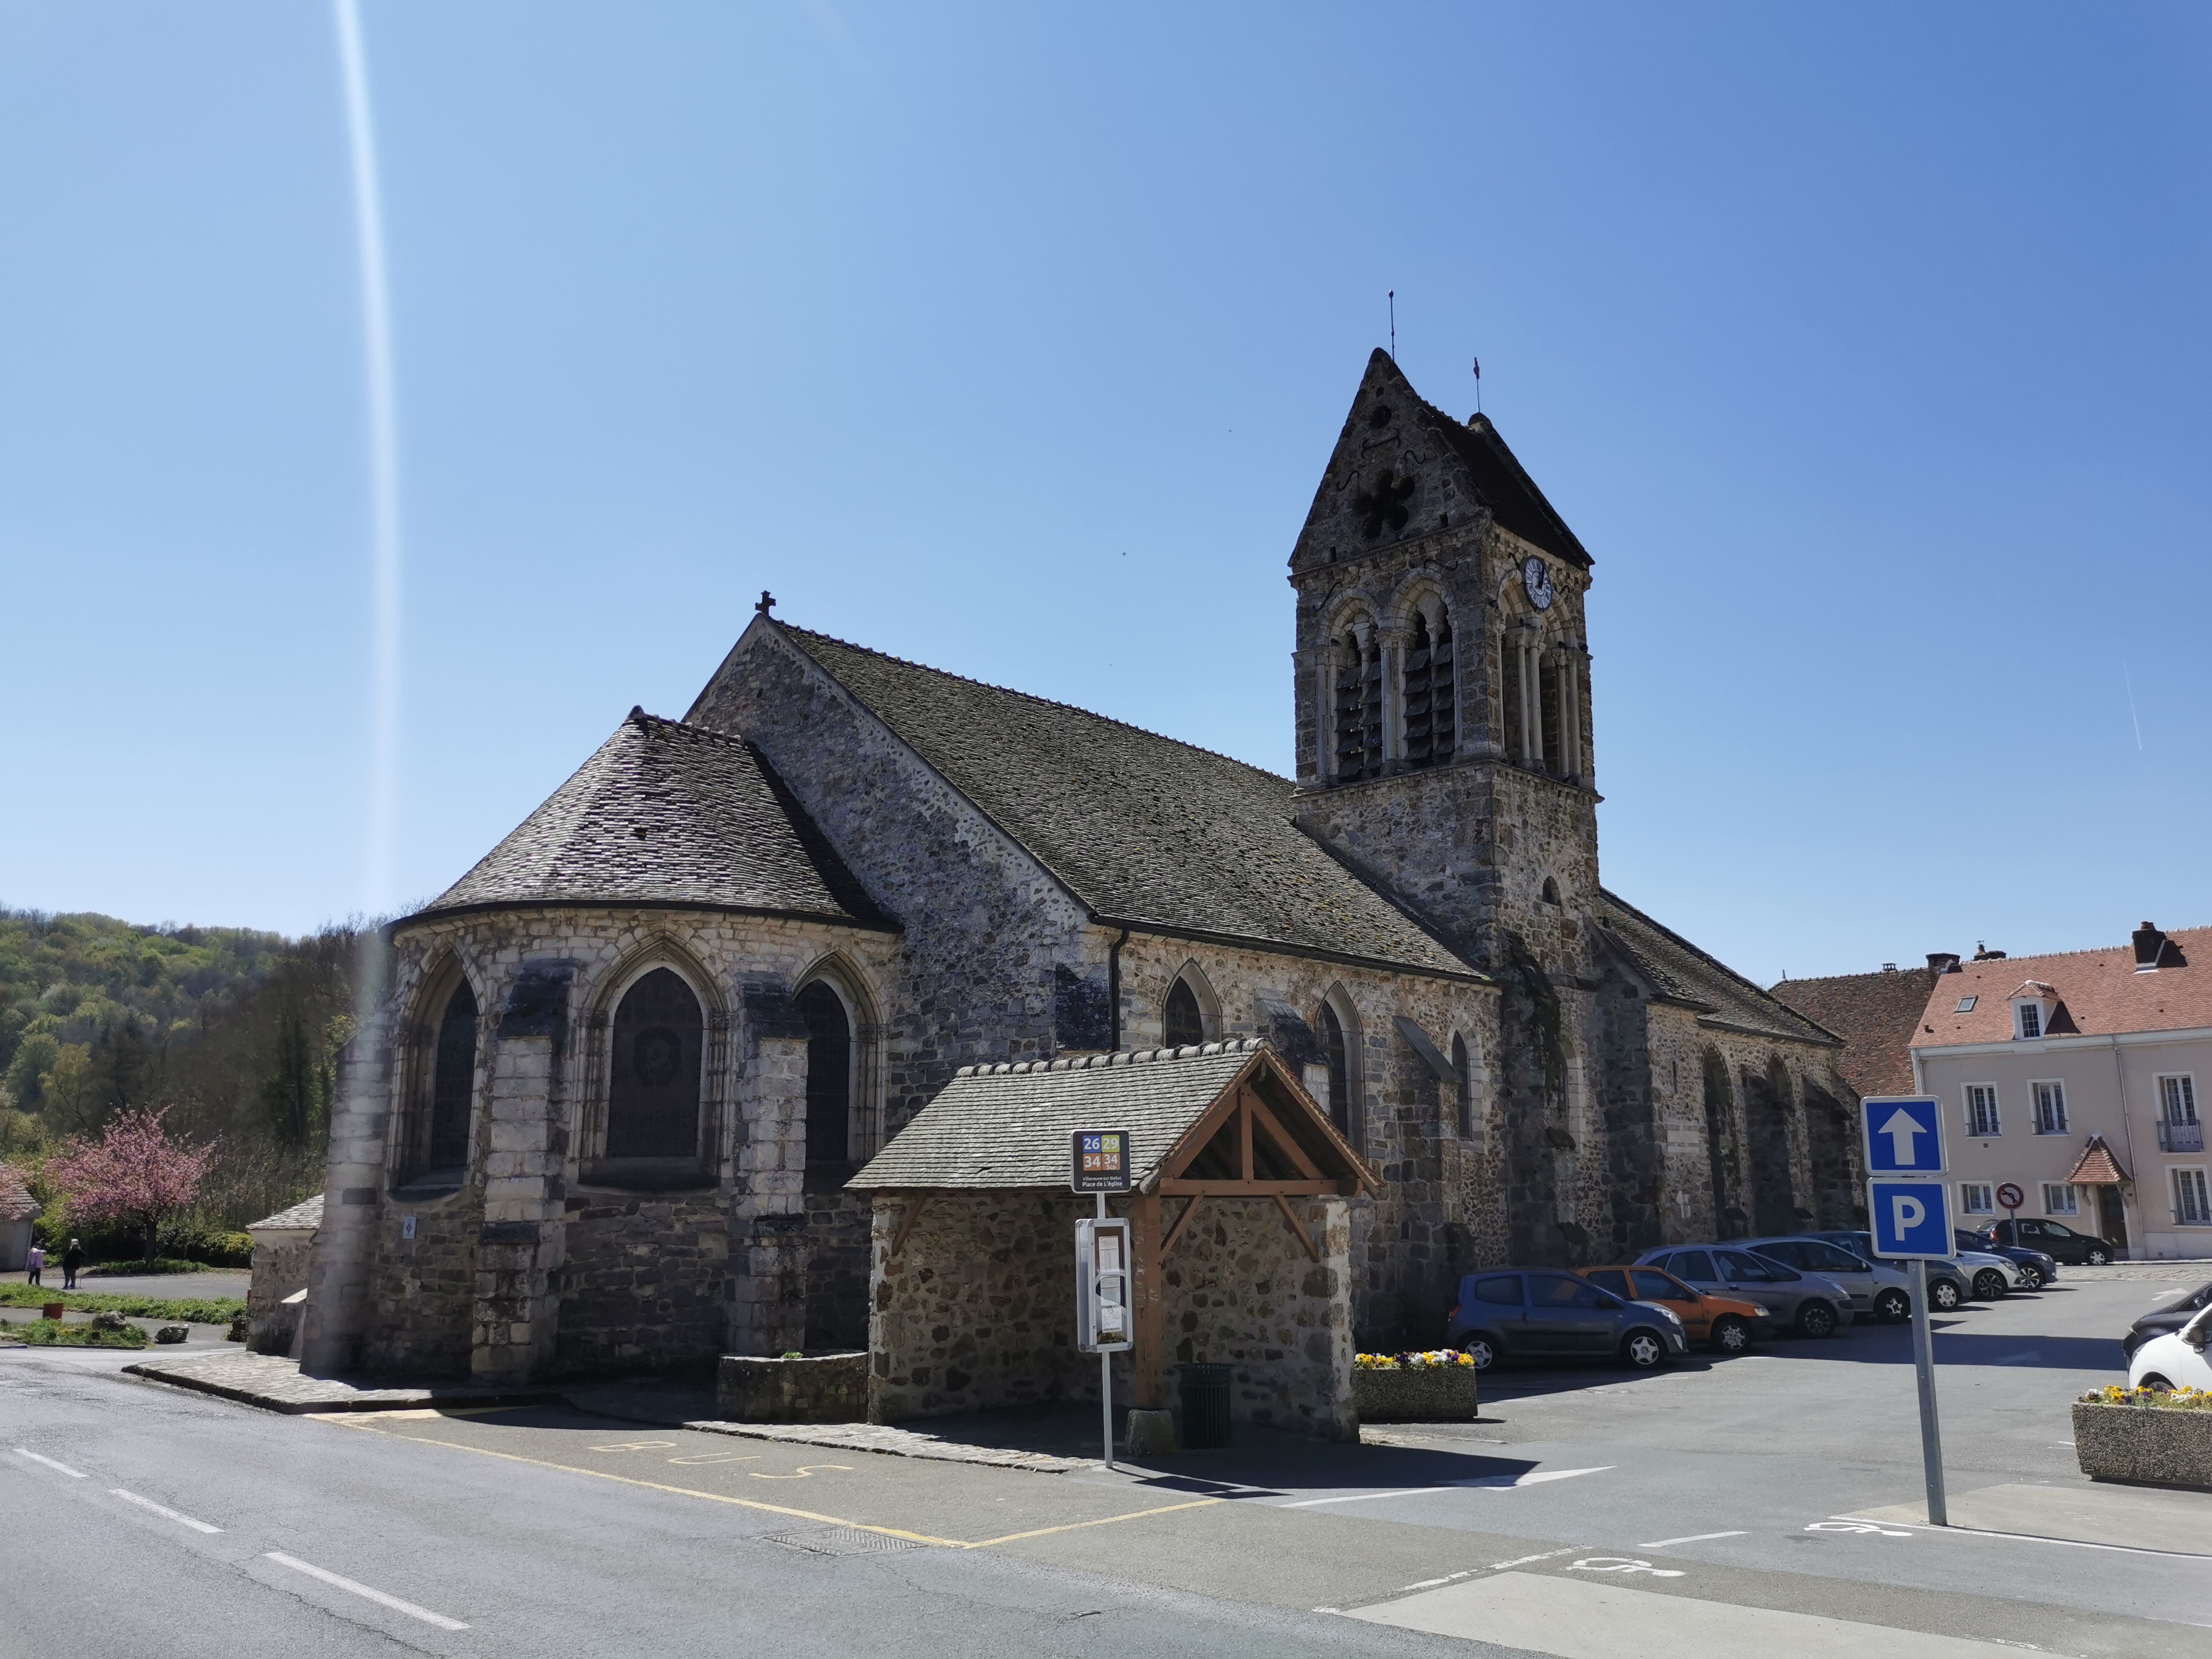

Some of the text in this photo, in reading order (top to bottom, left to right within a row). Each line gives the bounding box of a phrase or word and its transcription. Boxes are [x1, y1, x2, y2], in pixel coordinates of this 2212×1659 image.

[1084, 1138, 1119, 1150] 26 29
[1084, 1154, 1118, 1168] 34 34
[1892, 1195, 1925, 1241] P
[589, 1441, 854, 1479] BUS
